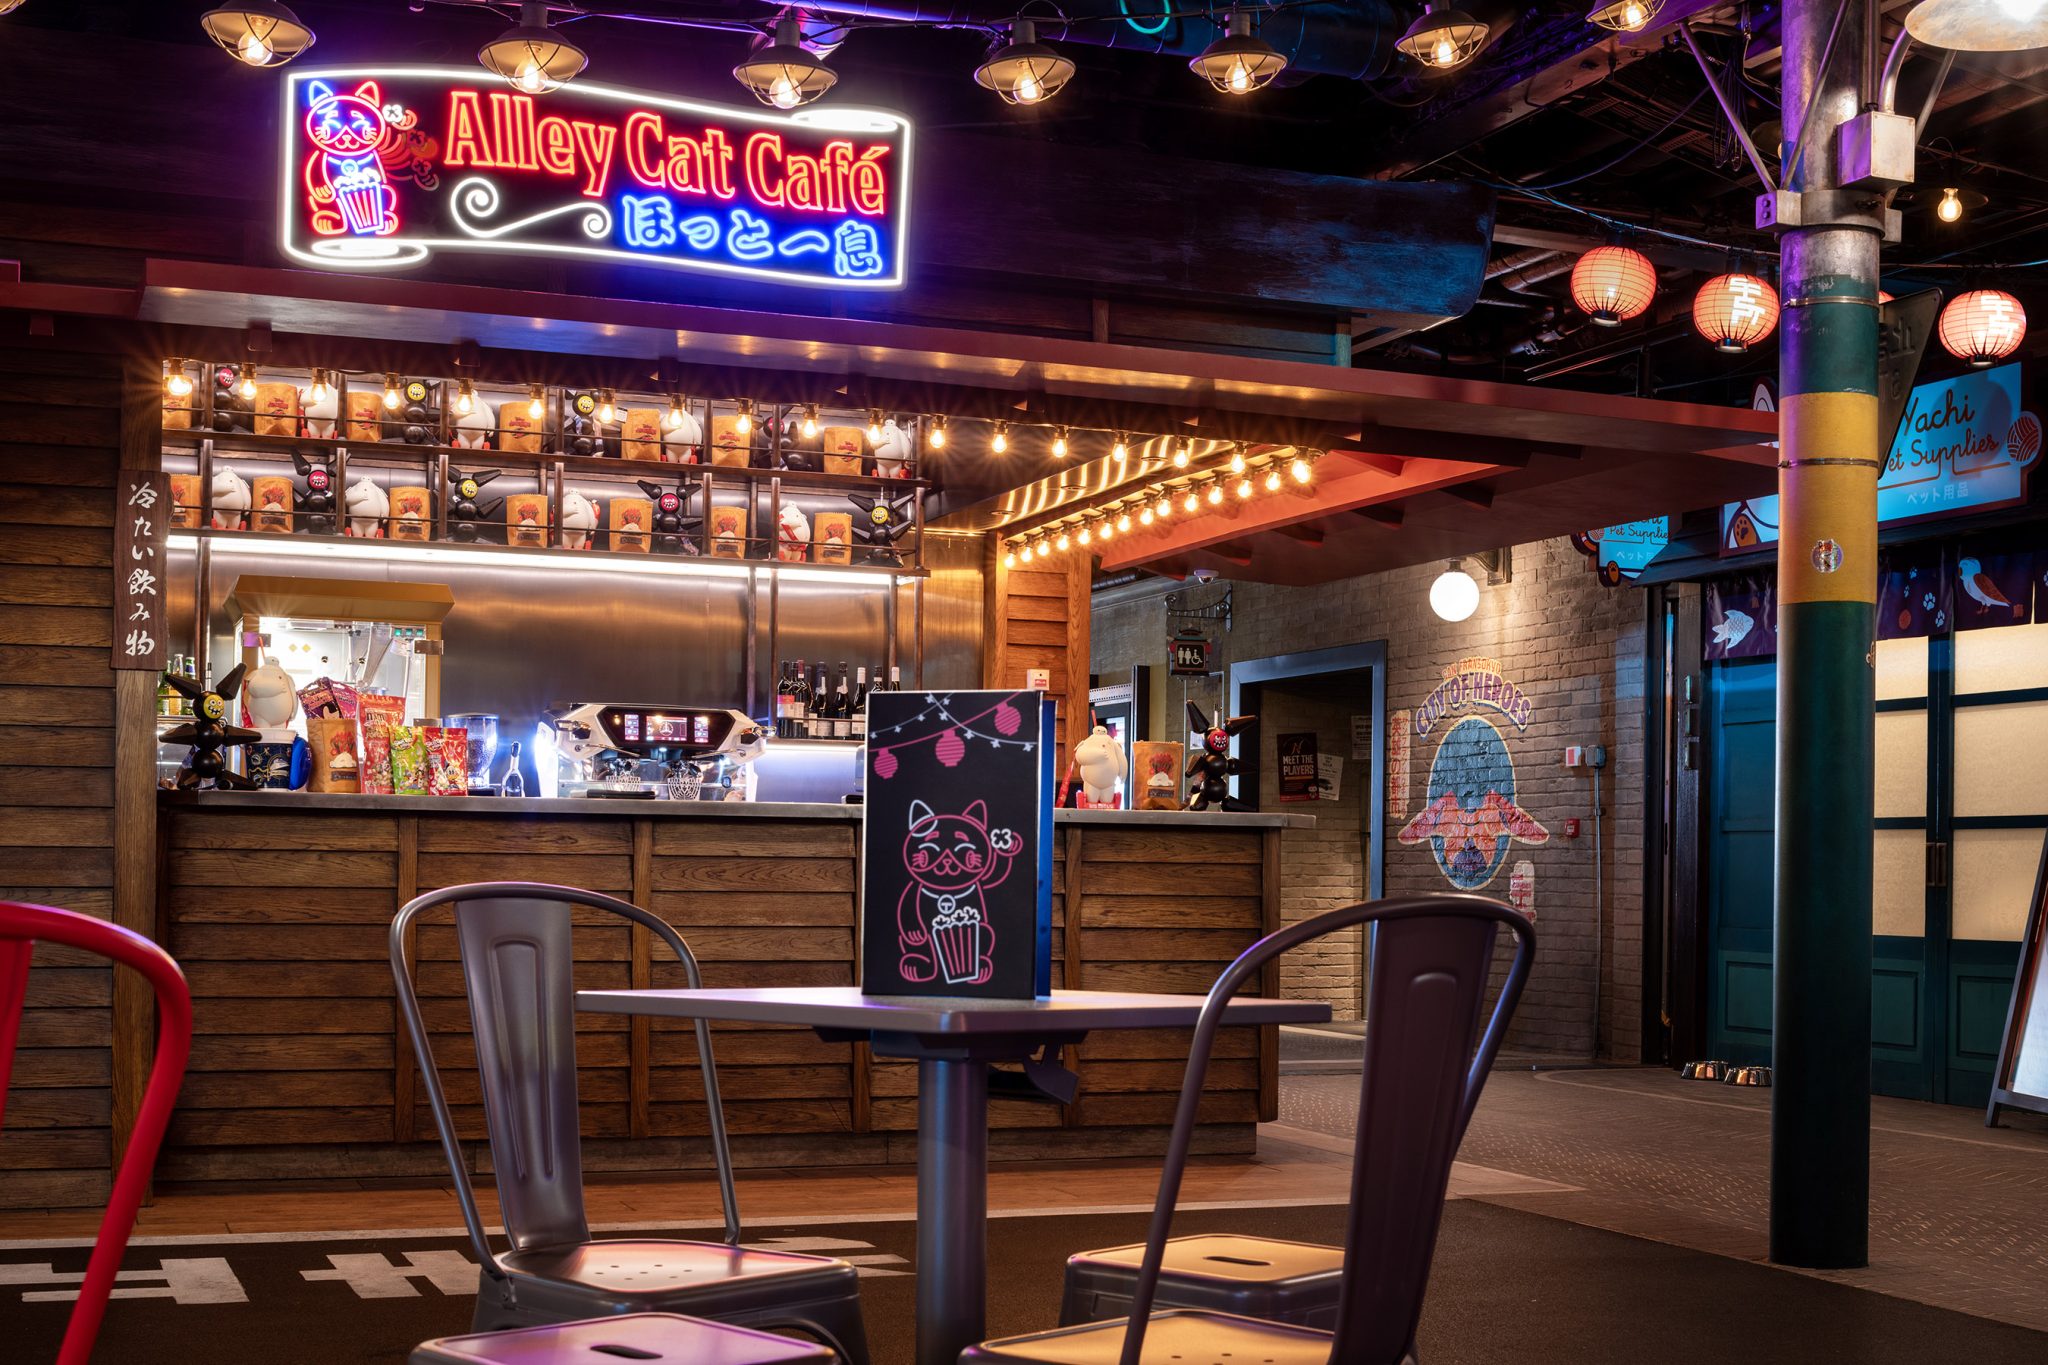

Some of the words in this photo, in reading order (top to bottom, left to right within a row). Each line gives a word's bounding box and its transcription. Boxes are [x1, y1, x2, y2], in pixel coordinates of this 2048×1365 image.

[442, 89, 617, 197] Alley
[625, 111, 735, 200] Cat
[744, 131, 890, 215] Café
[622, 196, 883, 277] ほっと一息
[1903, 388, 1975, 437] Yachi
[1887, 450, 1905, 472] et
[1911, 428, 1999, 472] Supplies
[1628, 524, 1668, 541] Supplie
[125, 481, 158, 656] 冷たい飲み物
[1442, 664, 1457, 680] SAN
[1459, 657, 1501, 675] FRANSOKYO
[1416, 683, 1447, 736] CITY
[1450, 674, 1471, 707] OF
[1473, 671, 1531, 728] HEROES
[1283, 756, 1300, 765] MEET
[1301, 754, 1314, 763] THE
[1283, 764, 1314, 776] PLAYERS
